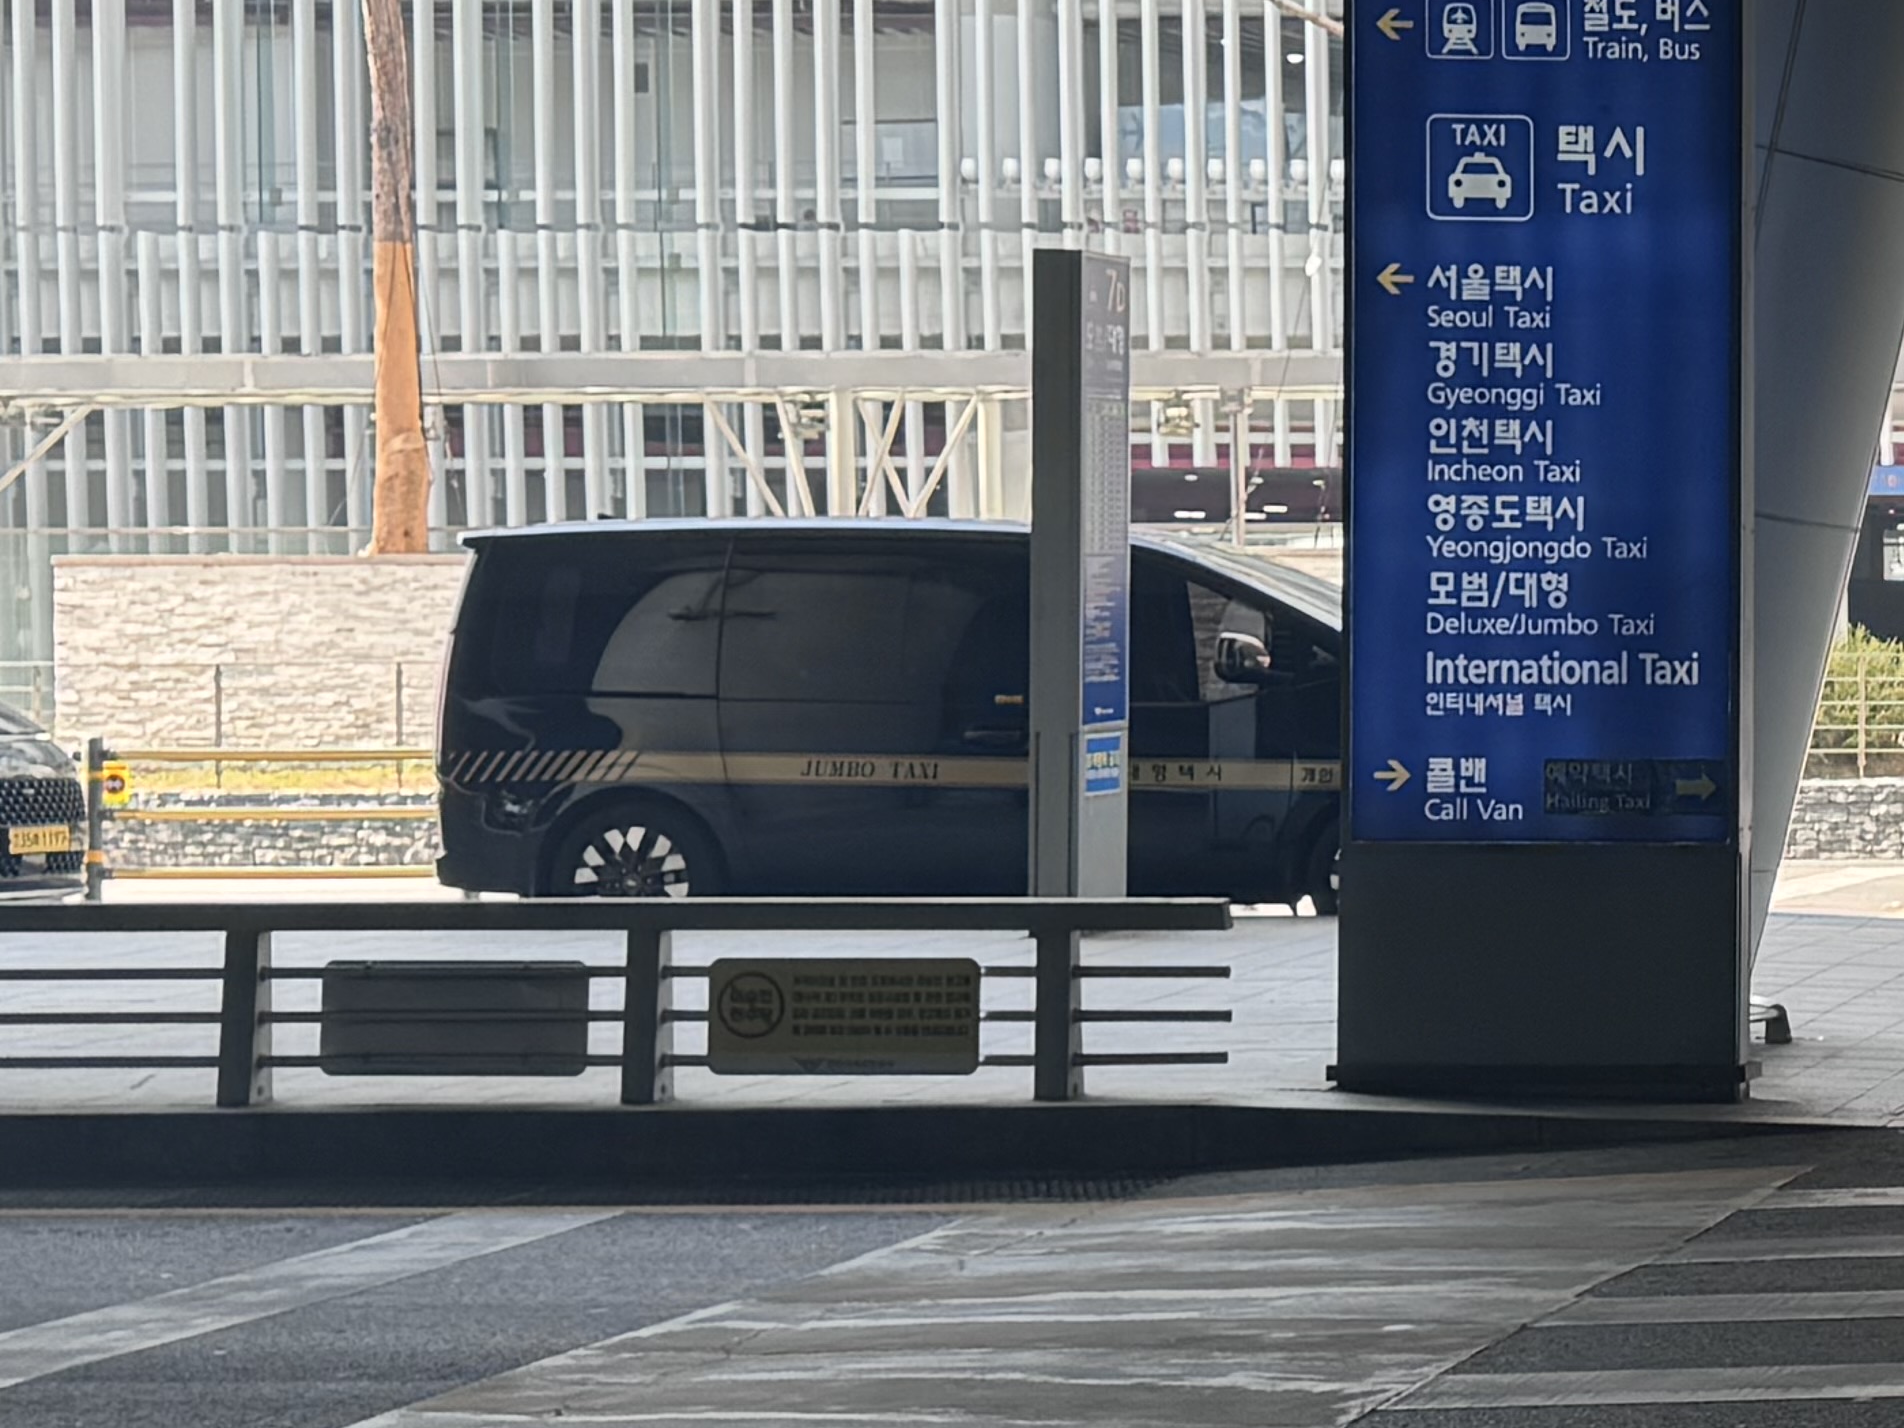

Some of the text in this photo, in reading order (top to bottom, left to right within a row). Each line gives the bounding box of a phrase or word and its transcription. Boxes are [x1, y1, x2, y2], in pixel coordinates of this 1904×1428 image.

[1582, 34, 1701, 63] Train, Bus
[1451, 123, 1506, 147] TAXI
[1556, 125, 1645, 177] 택시
[1557, 182, 1633, 215] Taxi
[1427, 263, 1554, 302] 서울택시
[1427, 304, 1551, 329] Seoul Taxi
[1428, 340, 1553, 379] 경기택시
[1427, 381, 1601, 411] Gyeonggi Taxi
[1428, 416, 1553, 456] 인천택시
[1427, 457, 1581, 483] Incheon Taxi
[1427, 493, 1585, 532] 영종도택시
[1425, 534, 1648, 565] Yeongjongdo Taxi
[1427, 570, 1569, 609] 모범/대형
[1426, 611, 1655, 636] Deluxe/Jumbo Taxi
[1426, 650, 1699, 686] International Taxi
[1425, 691, 1572, 717] 인터내셔널 택시
[801, 760, 939, 779] JUMBO TAXI
[1426, 757, 1487, 794] 콜밴
[1424, 797, 1524, 821] Call Van
[1545, 792, 1651, 812] Hailing Taxi
